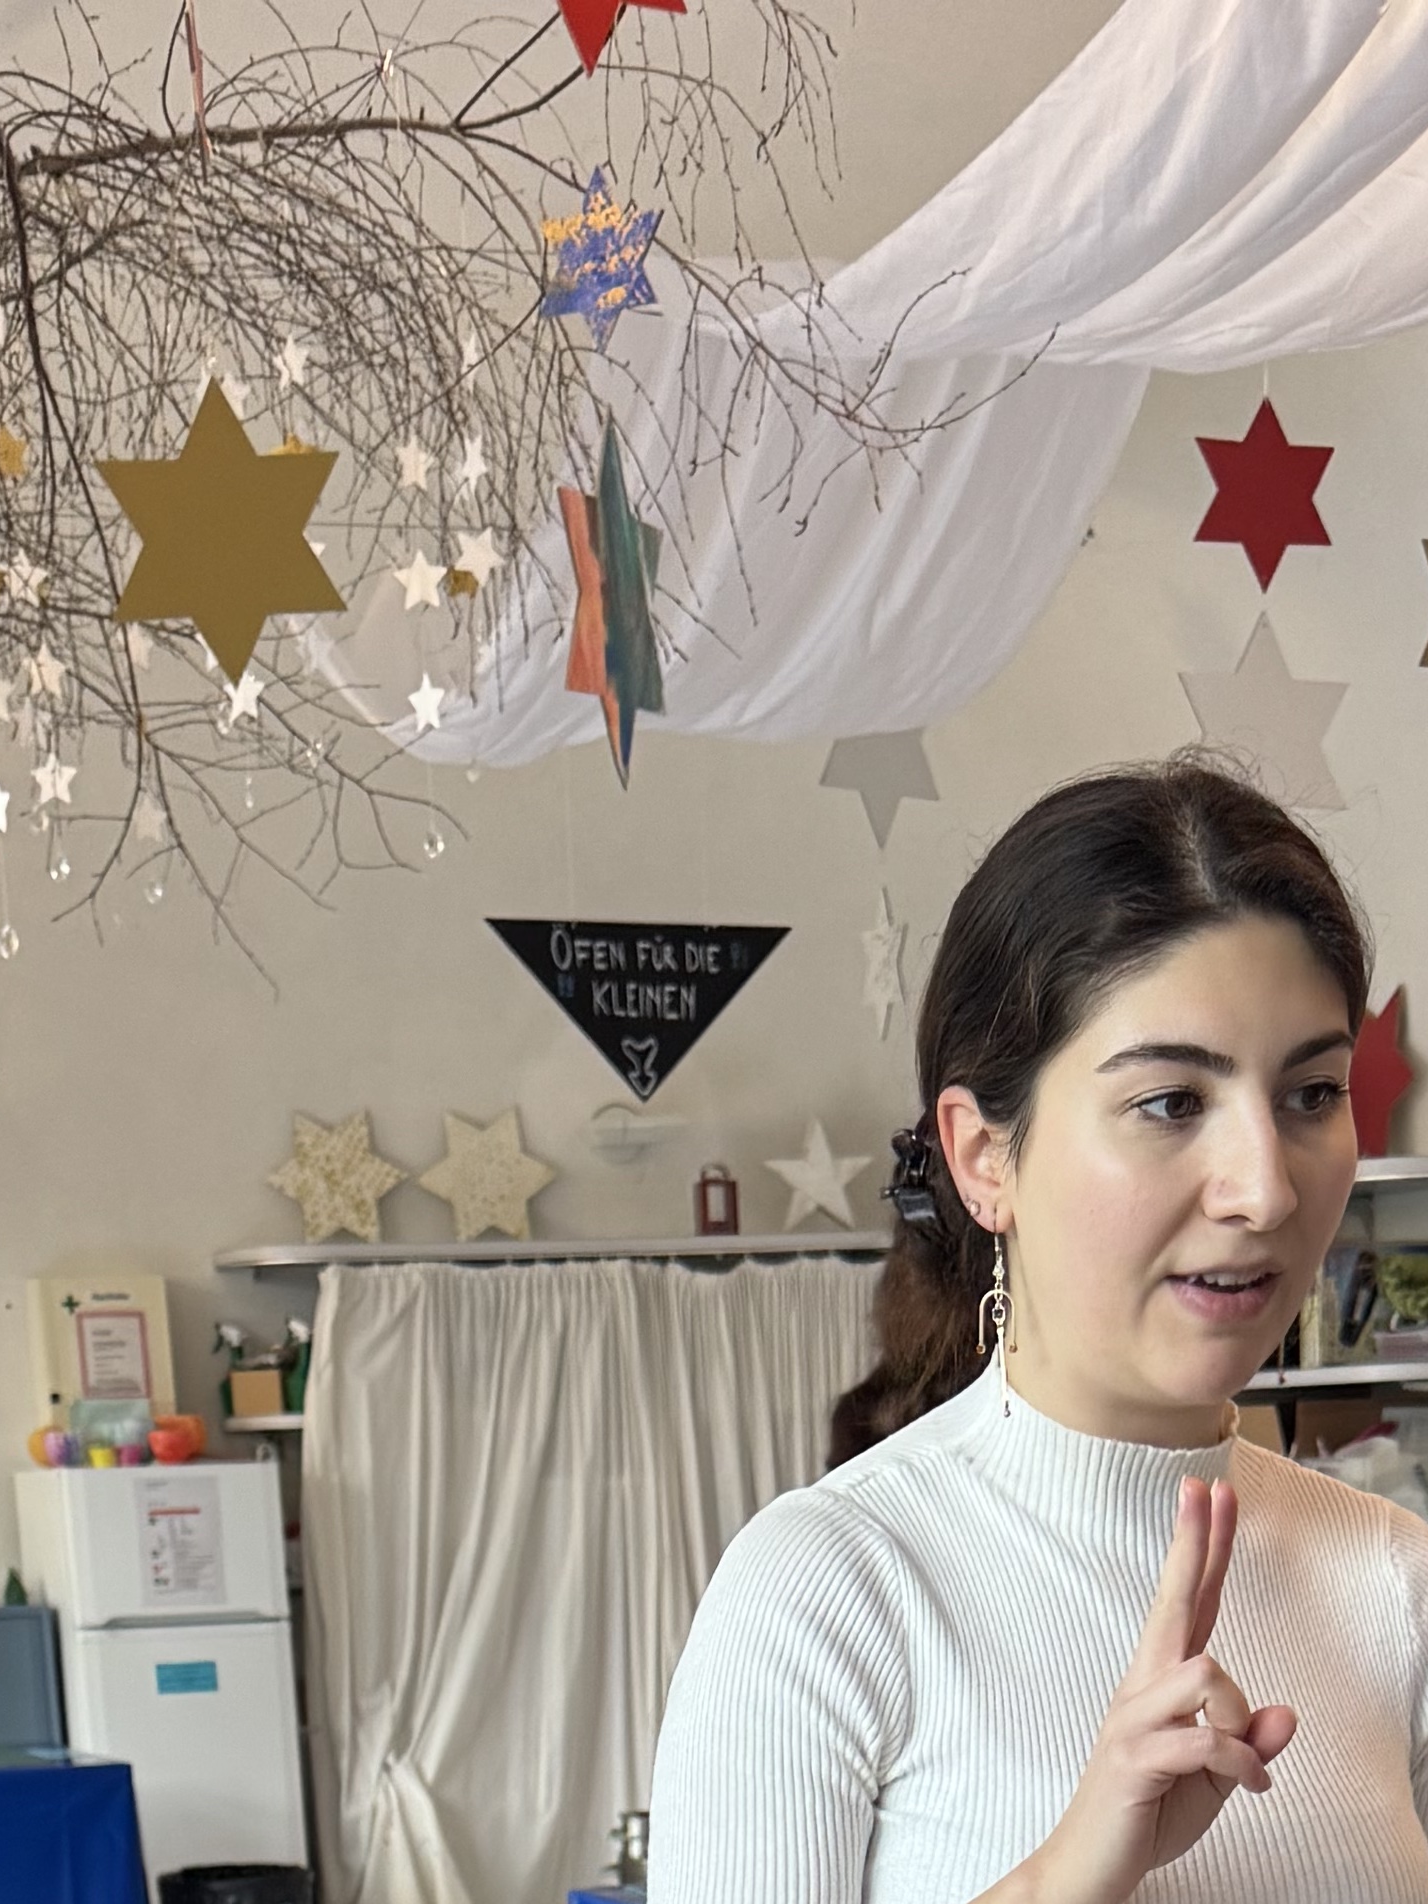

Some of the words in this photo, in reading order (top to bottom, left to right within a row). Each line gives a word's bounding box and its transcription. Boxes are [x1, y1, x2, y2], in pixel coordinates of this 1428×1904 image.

[549, 922, 627, 972] ÖFEN
[635, 934, 679, 973] FÜR
[684, 941, 722, 975] DIE
[590, 978, 698, 1021] KLEINEN
